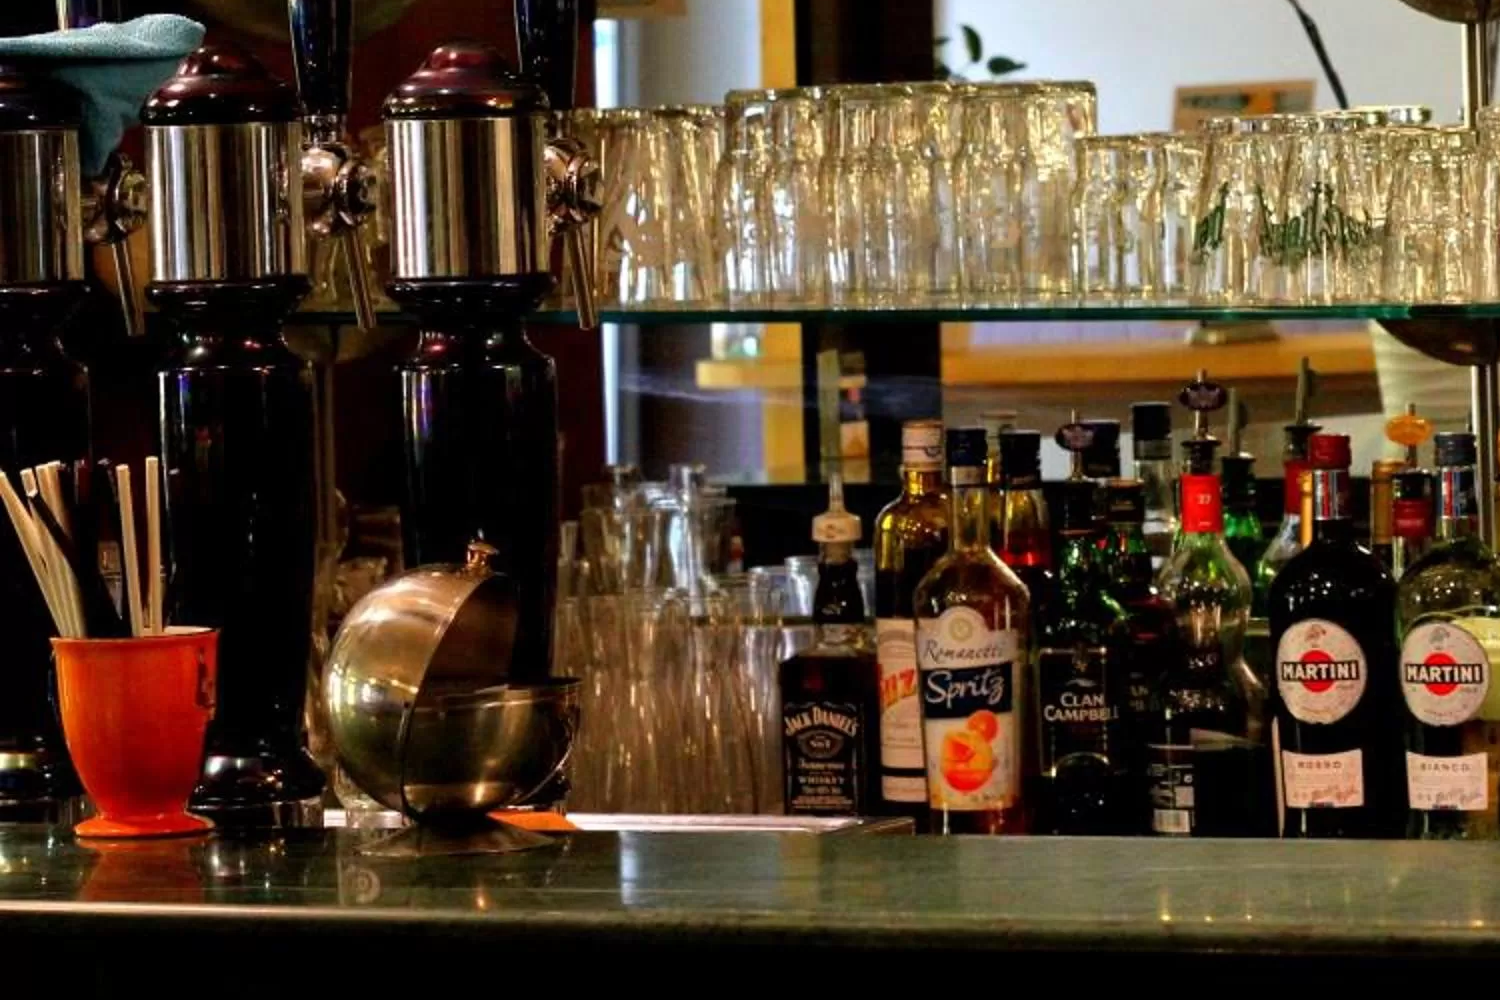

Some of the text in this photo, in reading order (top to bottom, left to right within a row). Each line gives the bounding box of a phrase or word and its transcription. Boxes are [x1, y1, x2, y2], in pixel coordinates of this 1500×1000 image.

[1283, 662, 1357, 680] MARTINI
[1407, 665, 1481, 683] MARTINI
[926, 668, 1005, 710] Spritz
[1060, 691, 1105, 707] CLAN
